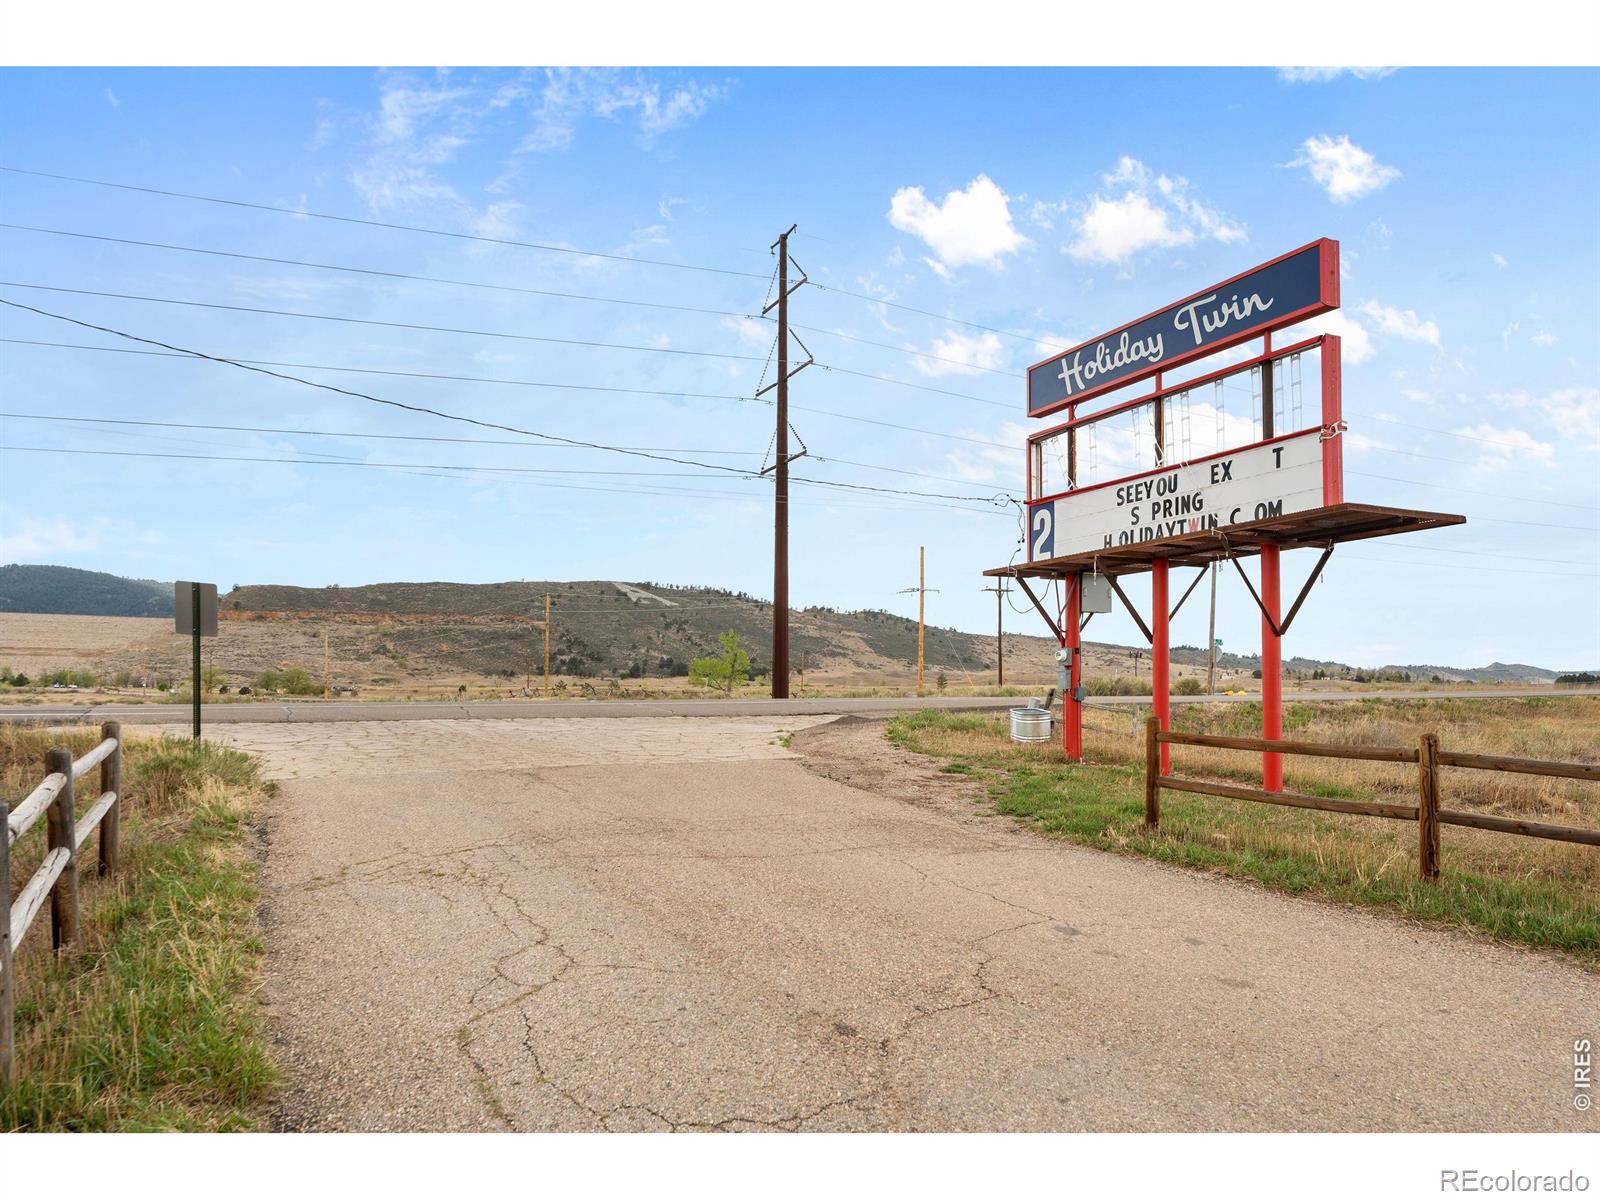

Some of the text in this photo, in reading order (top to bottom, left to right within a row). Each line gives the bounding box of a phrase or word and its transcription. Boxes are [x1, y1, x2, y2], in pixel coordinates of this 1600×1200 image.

[1057, 293, 1274, 395] Holiday Twin
[1210, 460, 1233, 484] EX
[1272, 446, 1284, 469] T
[1033, 509, 1052, 562] 2
